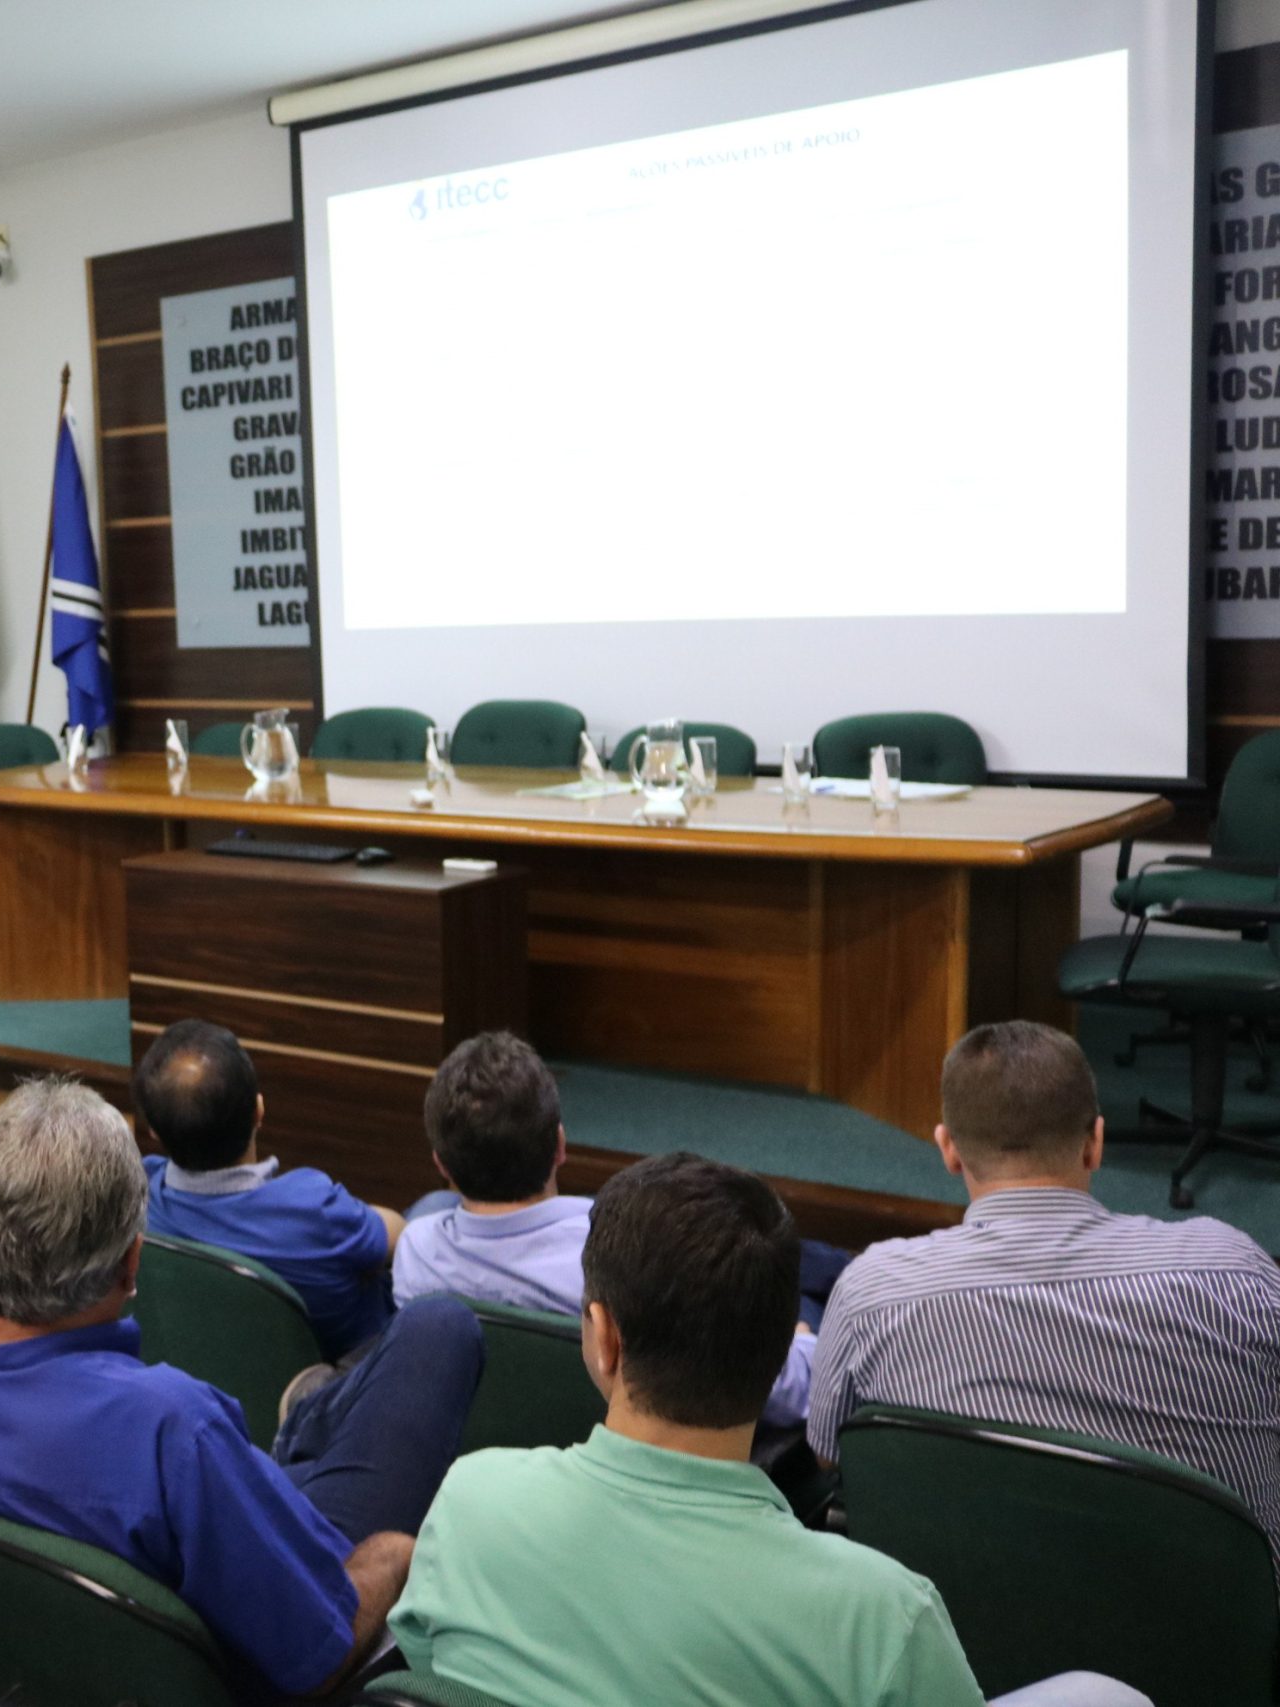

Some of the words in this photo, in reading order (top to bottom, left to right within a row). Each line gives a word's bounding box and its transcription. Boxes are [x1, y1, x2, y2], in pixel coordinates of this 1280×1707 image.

[801, 128, 862, 150] APOIO
[1211, 167, 1244, 204] S
[1215, 265, 1280, 306] FOR
[231, 298, 297, 331] ARMA
[1209, 316, 1280, 357] ANG
[190, 339, 270, 374] BRAÇO
[277, 336, 294, 361] D
[181, 374, 292, 411] CAPIVARI
[233, 411, 298, 441] GRAV
[1217, 415, 1280, 453] LUD
[230, 446, 295, 478] GRÃO
[254, 487, 302, 514] IMA
[1239, 517, 1280, 550] DE
[233, 564, 308, 591] JAGUA
